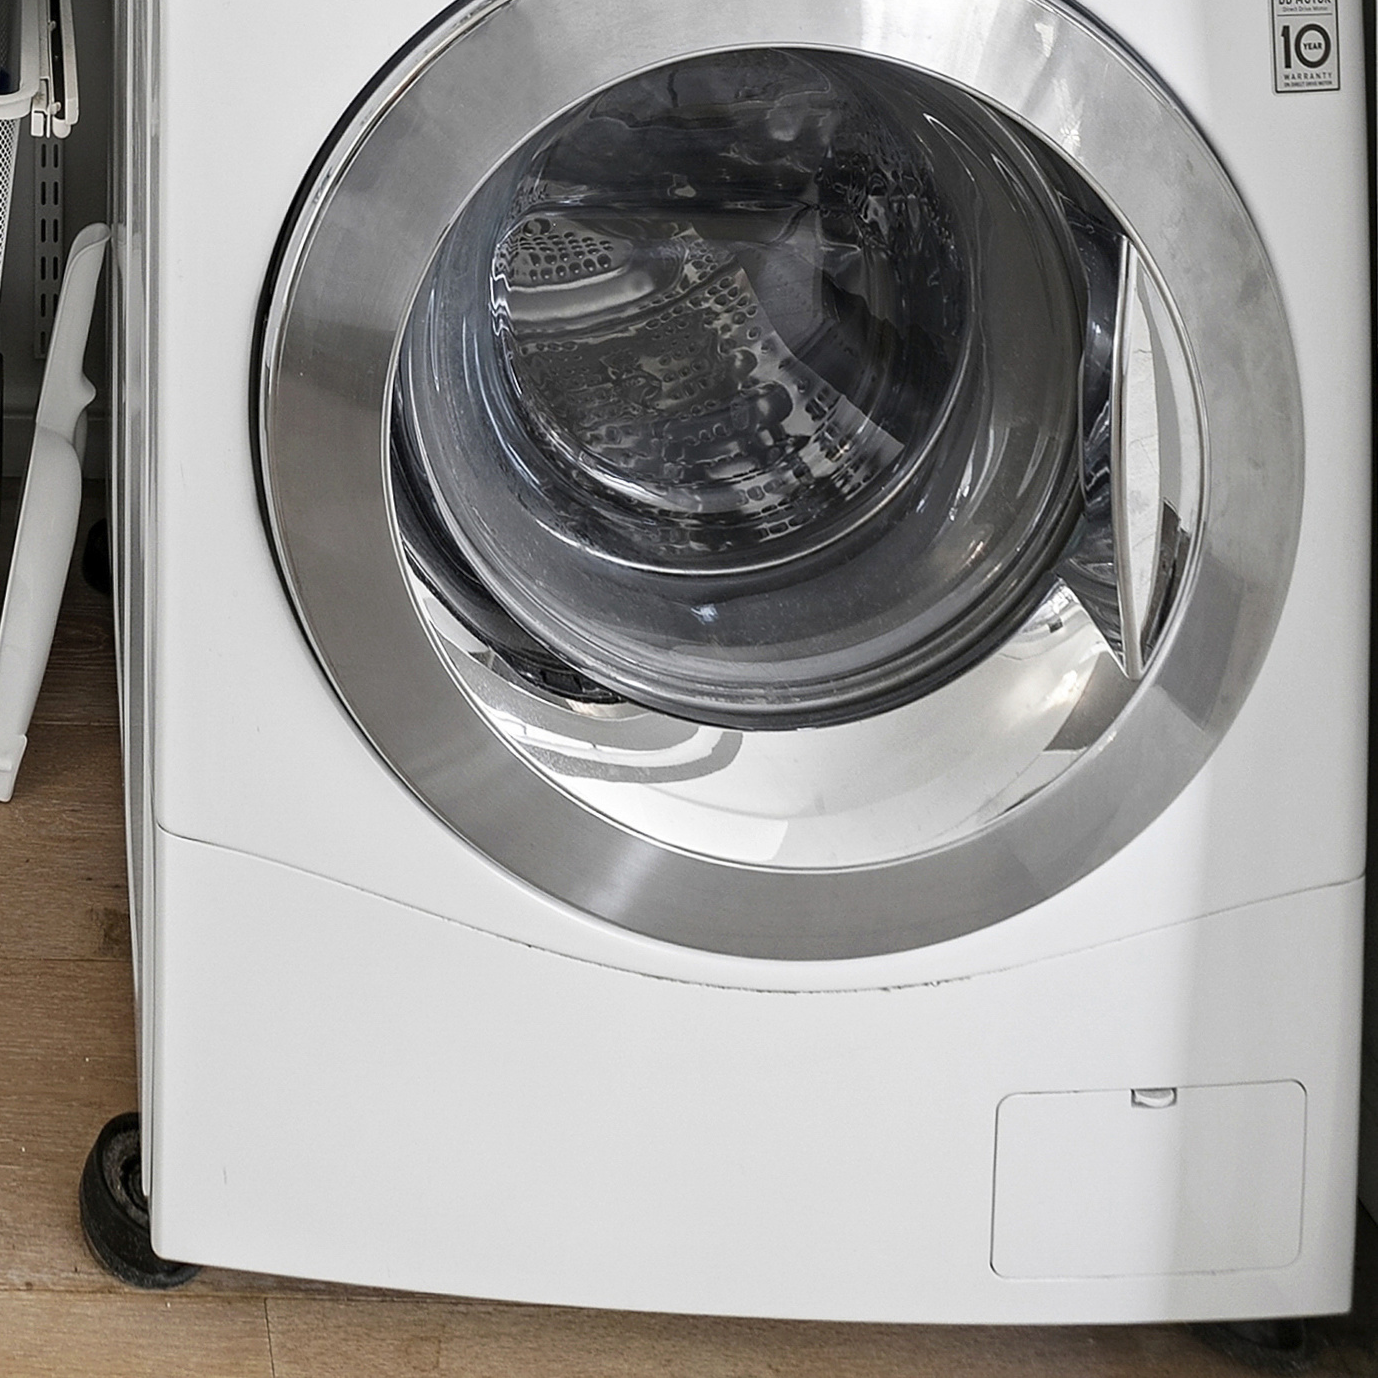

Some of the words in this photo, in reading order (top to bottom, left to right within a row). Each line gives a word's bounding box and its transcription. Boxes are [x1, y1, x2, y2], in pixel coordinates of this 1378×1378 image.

[1280, 23, 1332, 69] 10
[1302, 42, 1323, 51] YEAR
[1283, 72, 1333, 81] WARRANTY
